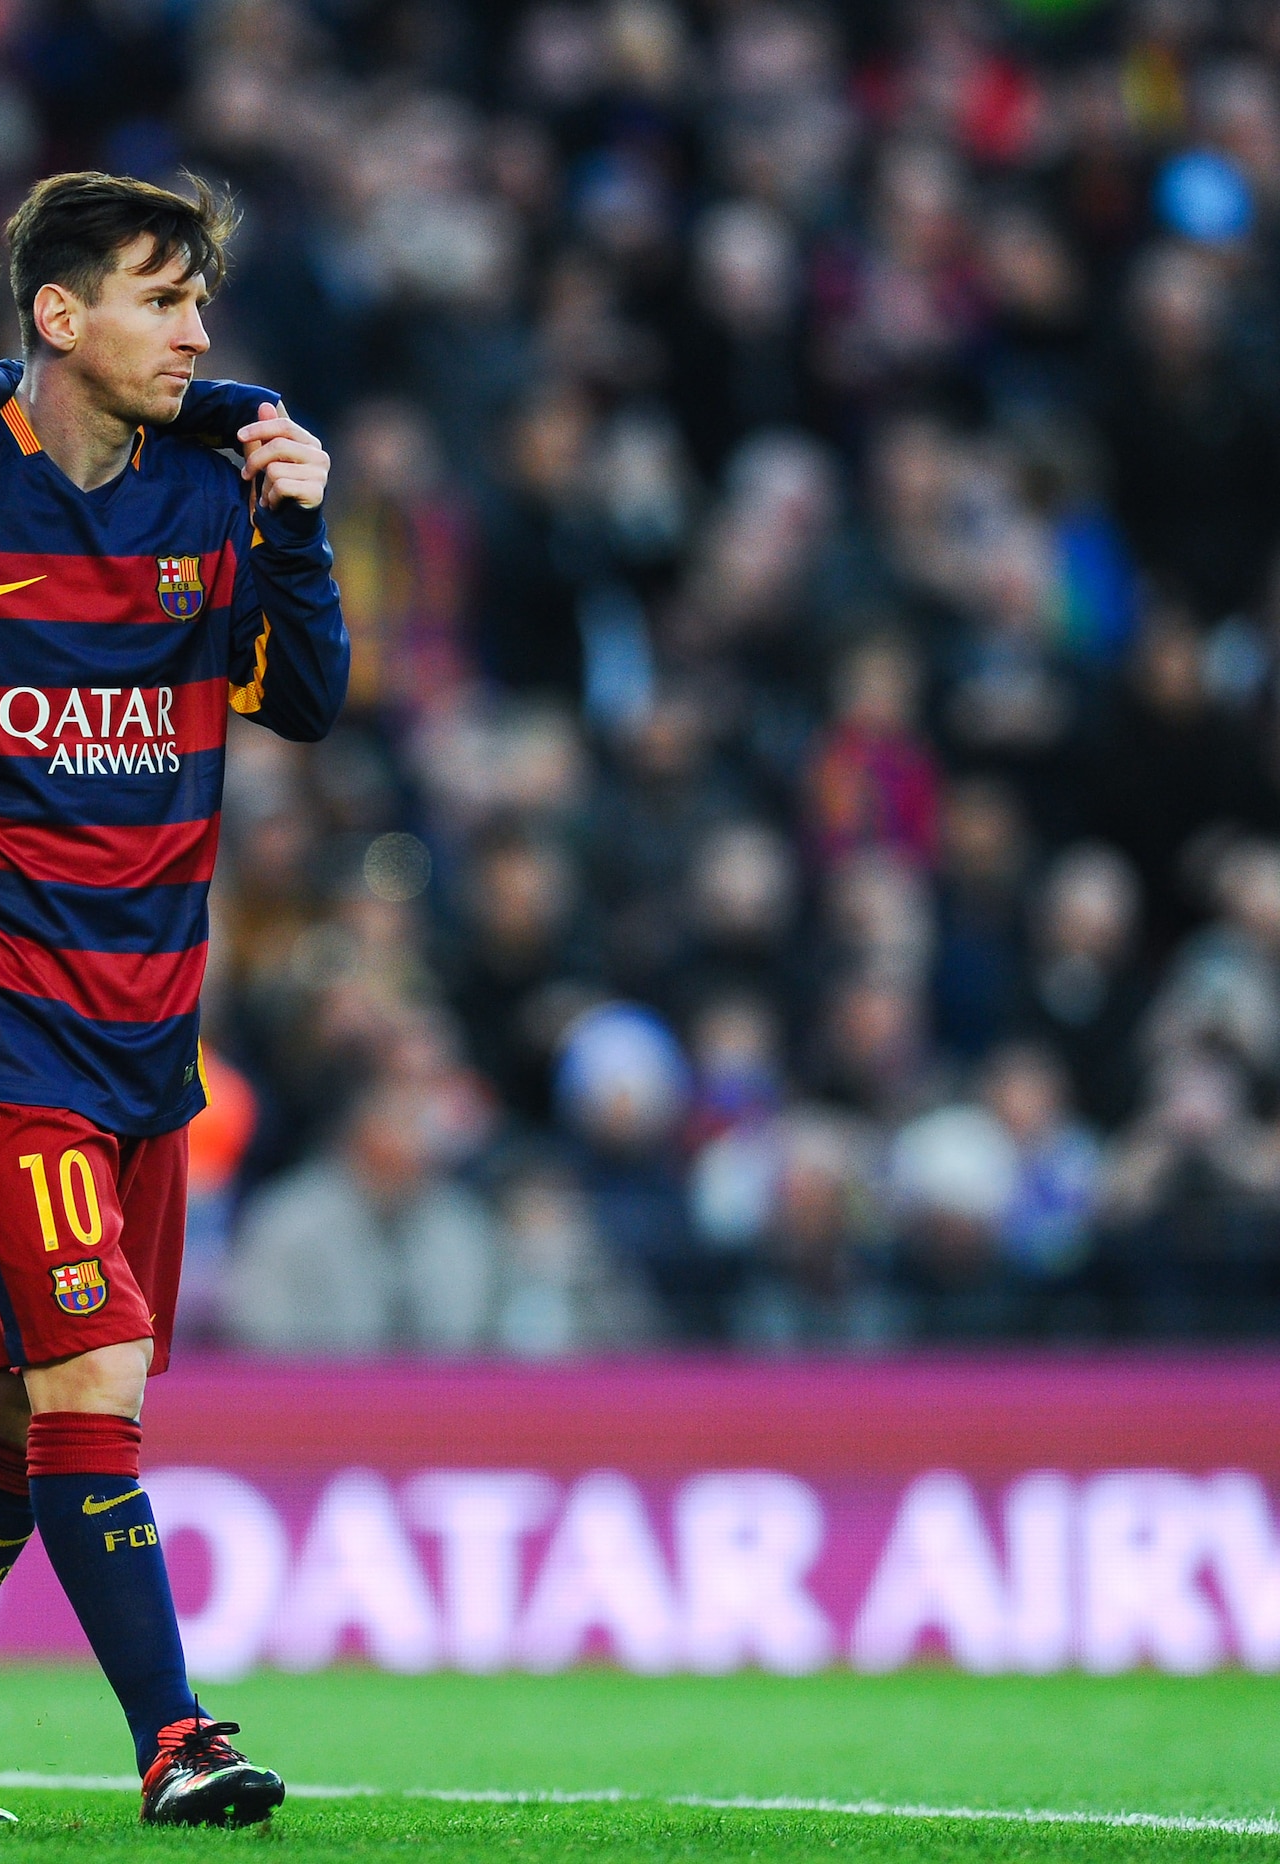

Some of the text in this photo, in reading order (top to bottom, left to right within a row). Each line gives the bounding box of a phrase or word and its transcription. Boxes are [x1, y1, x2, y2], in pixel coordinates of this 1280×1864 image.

[171, 583, 189, 591] FCB
[48, 741, 180, 775] AIRWAYS
[19, 1149, 103, 1252] 10
[104, 1523, 158, 1552] FCB
